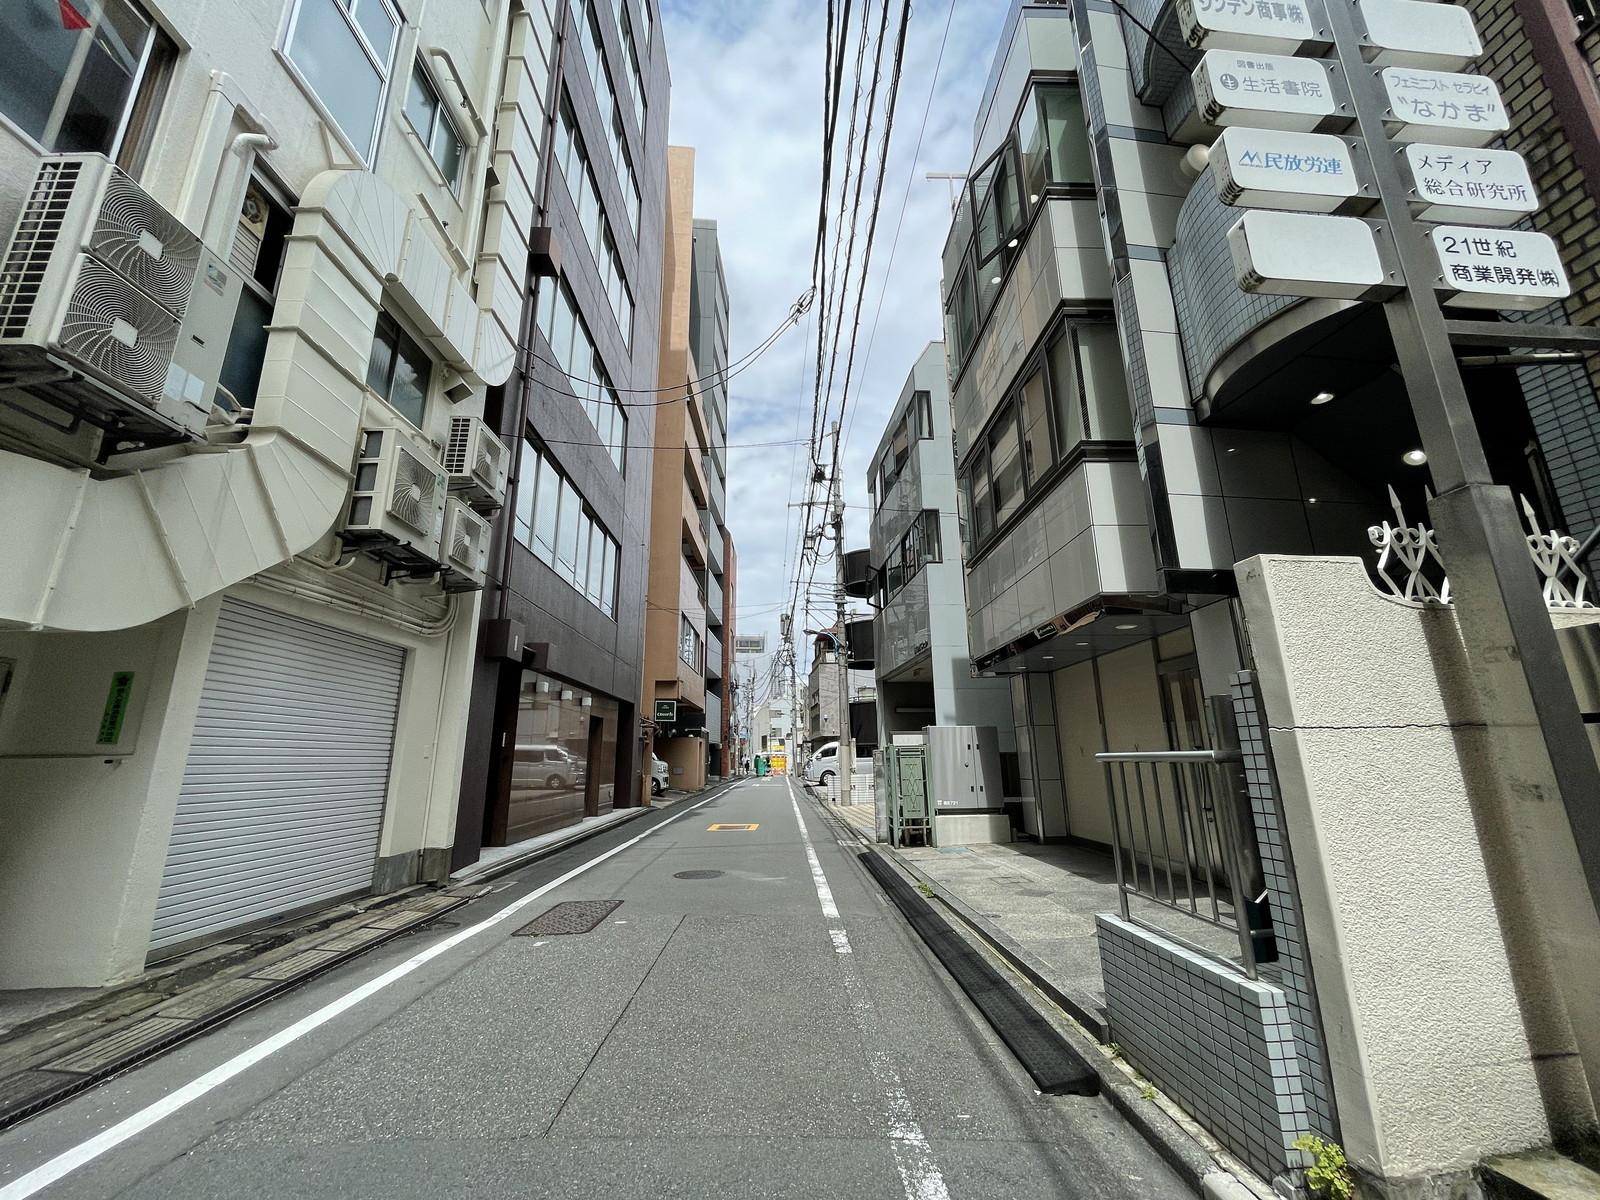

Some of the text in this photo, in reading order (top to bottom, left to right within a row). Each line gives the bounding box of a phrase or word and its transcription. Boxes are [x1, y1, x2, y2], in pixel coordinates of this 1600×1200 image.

[1242, 76, 1323, 98] 生活書院
[1390, 75, 1450, 91] フェミニスト
[1264, 152, 1343, 175] 民放労連
[1418, 154, 1492, 175] メディア
[1423, 177, 1528, 202] 総合研究所
[1442, 236, 1517, 258] 21世紀
